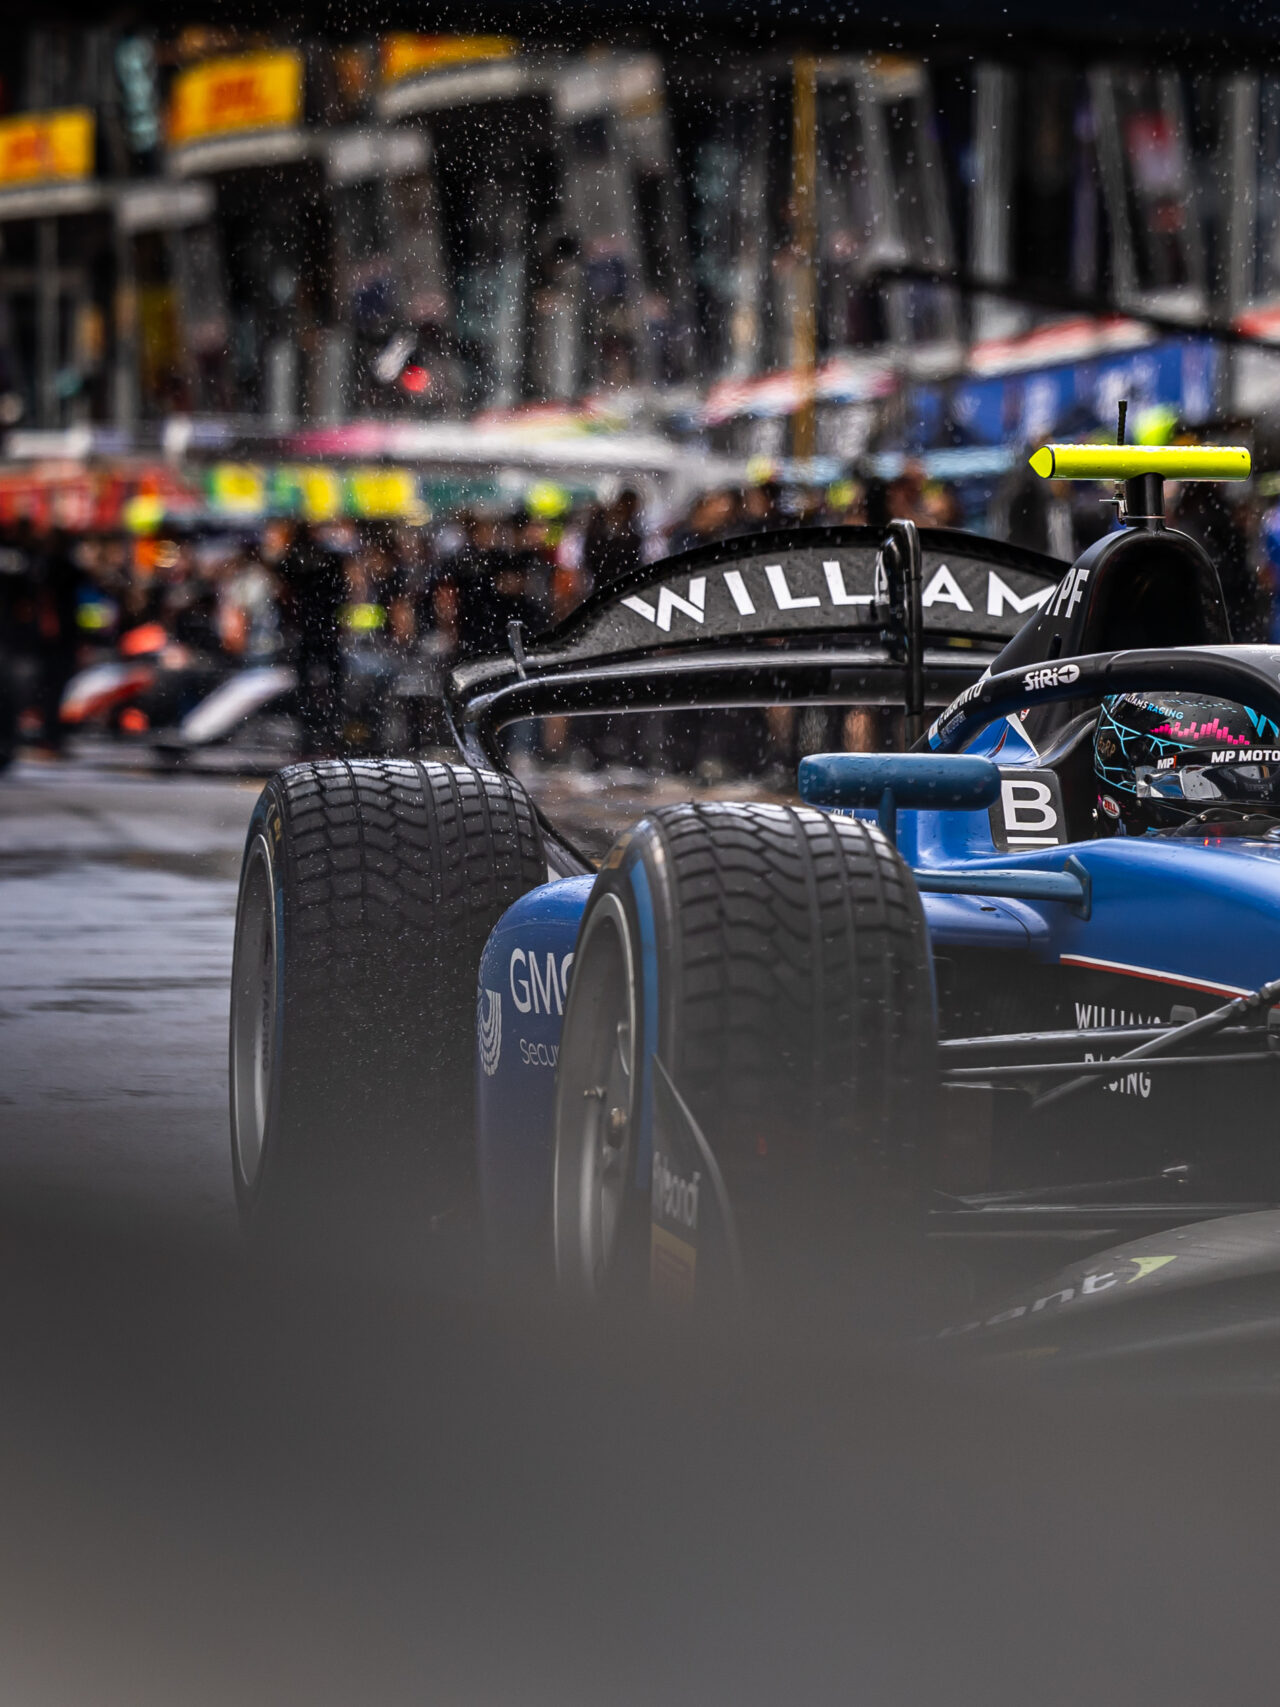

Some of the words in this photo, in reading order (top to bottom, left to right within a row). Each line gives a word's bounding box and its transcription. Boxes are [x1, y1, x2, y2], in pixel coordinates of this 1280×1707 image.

[620, 560, 1058, 633] WILLAM
[1211, 751, 1236, 764] MP
[1000, 779, 1058, 831] B
